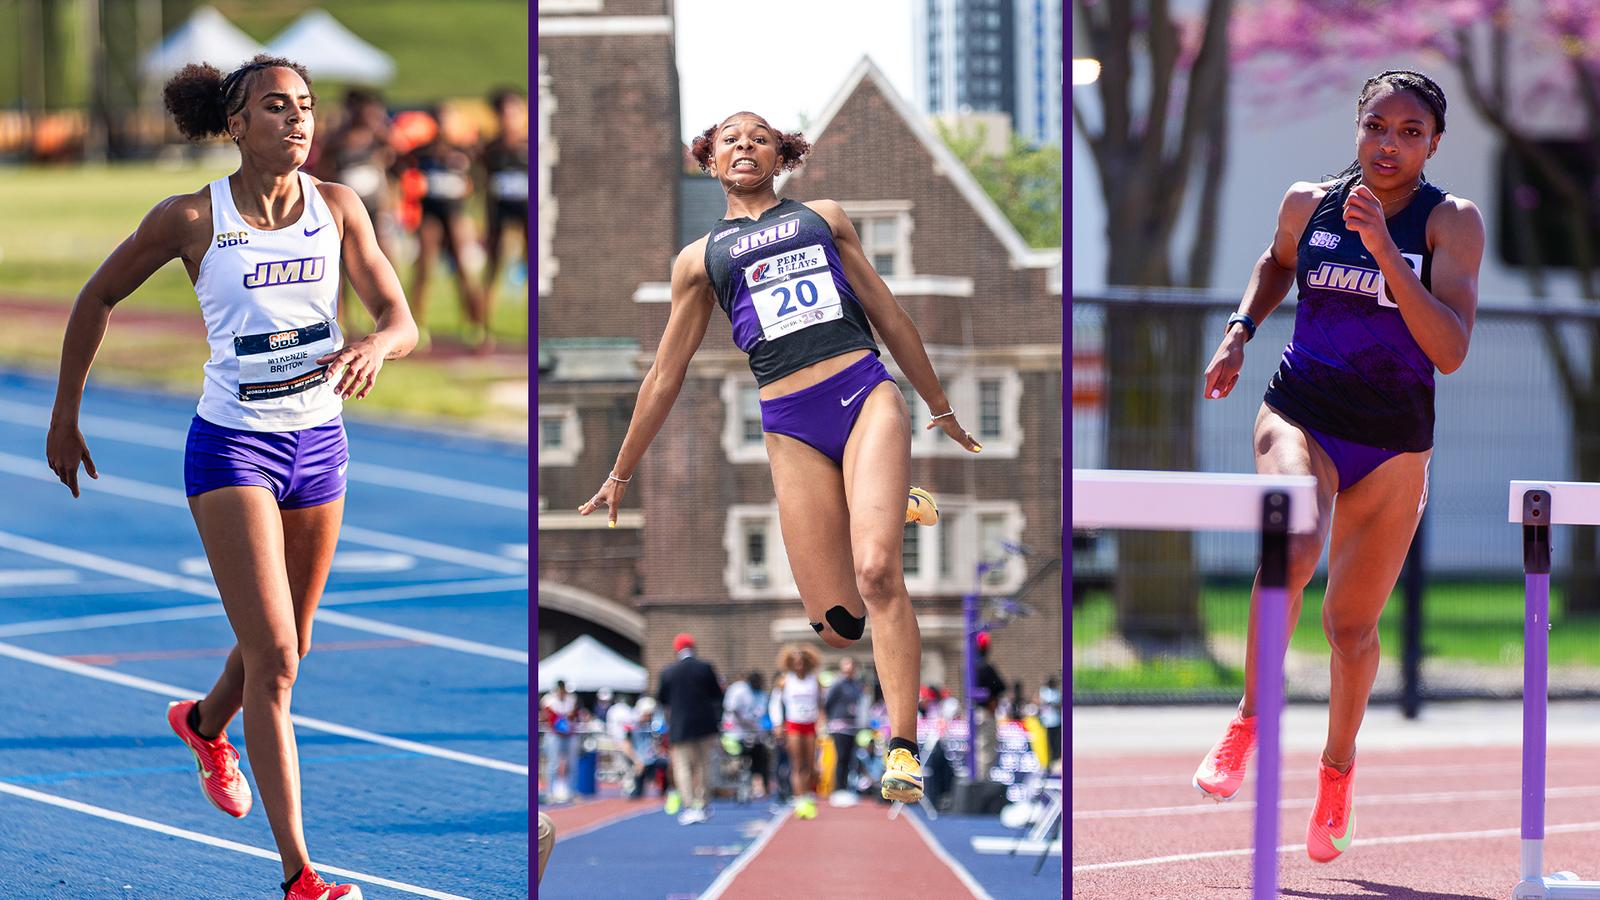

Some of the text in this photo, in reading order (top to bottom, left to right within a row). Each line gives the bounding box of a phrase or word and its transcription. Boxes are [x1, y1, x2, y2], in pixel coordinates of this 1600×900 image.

[217, 231, 249, 248] SBC
[731, 219, 800, 258] JMU
[1309, 230, 1341, 250] SBC
[777, 252, 807, 267] PENN
[778, 258, 818, 275] RELAYS
[244, 257, 325, 289] JMU
[1307, 262, 1380, 297] JMU
[771, 280, 818, 318] 20
[269, 331, 300, 349] SBC
[270, 361, 304, 373] BRITTON
